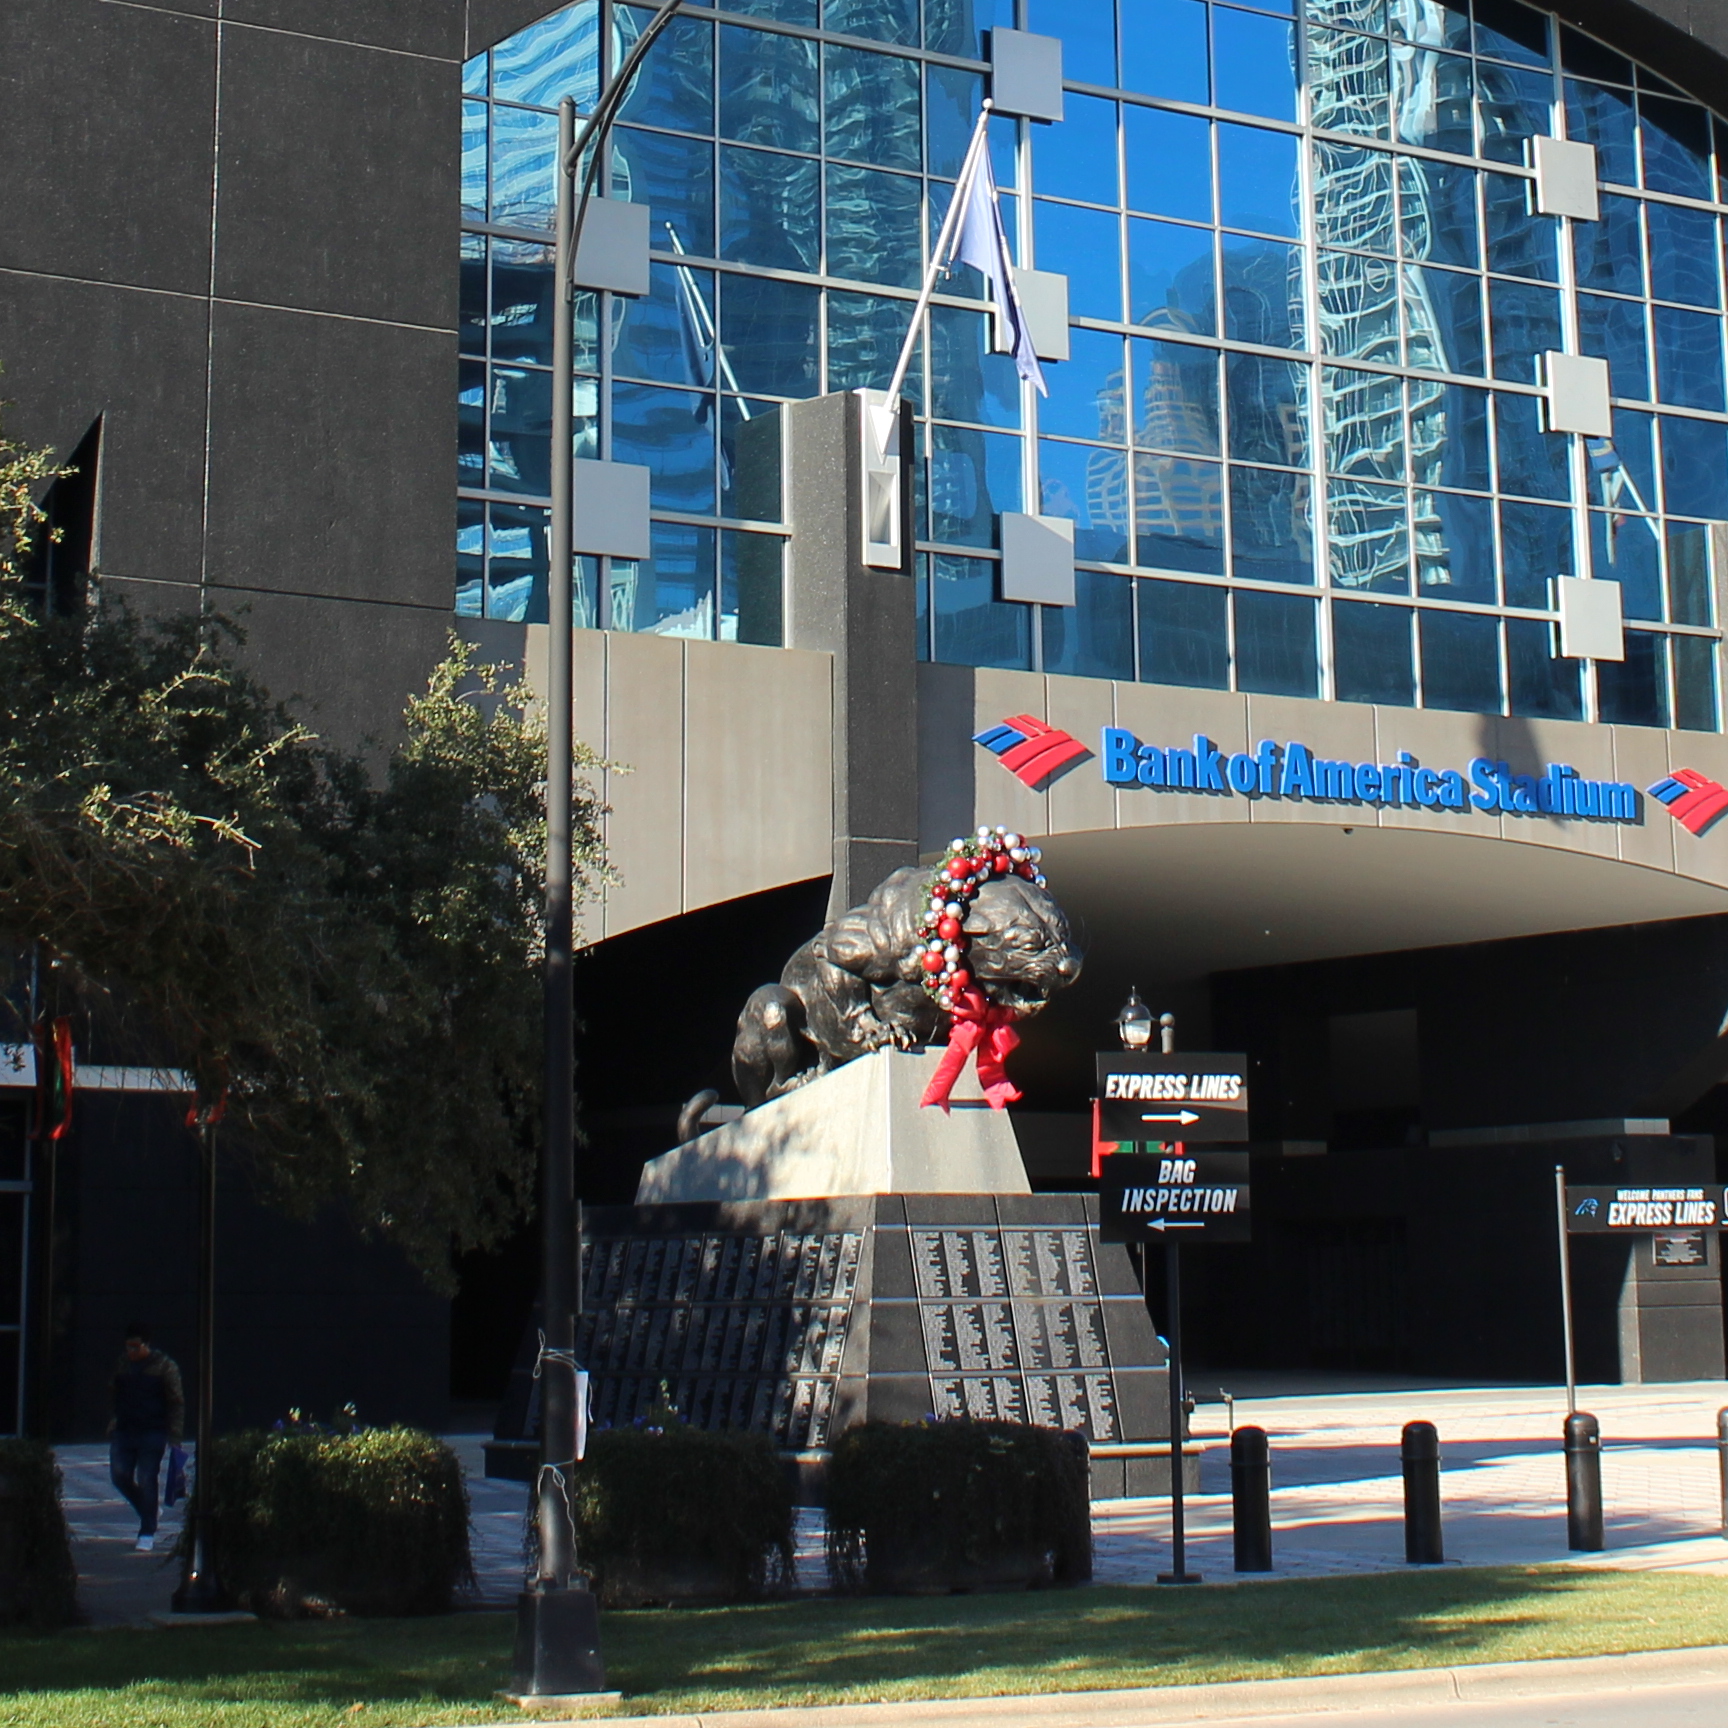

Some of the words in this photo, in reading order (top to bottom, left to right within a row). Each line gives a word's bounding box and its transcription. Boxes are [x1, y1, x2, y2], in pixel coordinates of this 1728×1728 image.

[1101, 726, 1226, 791] Bank
[1227, 739, 1278, 794] of
[1280, 741, 1463, 808] America
[1467, 757, 1637, 820] Stadium
[1105, 1074, 1188, 1099] EXPRESS
[1190, 1075, 1243, 1100] LINES
[1158, 1160, 1196, 1184] BAG
[1122, 1188, 1238, 1212] INSPECTION
[1617, 1189, 1650, 1201] WELCOME
[1608, 1201, 1673, 1226] EXPRESS
[1674, 1201, 1717, 1226] LINES
